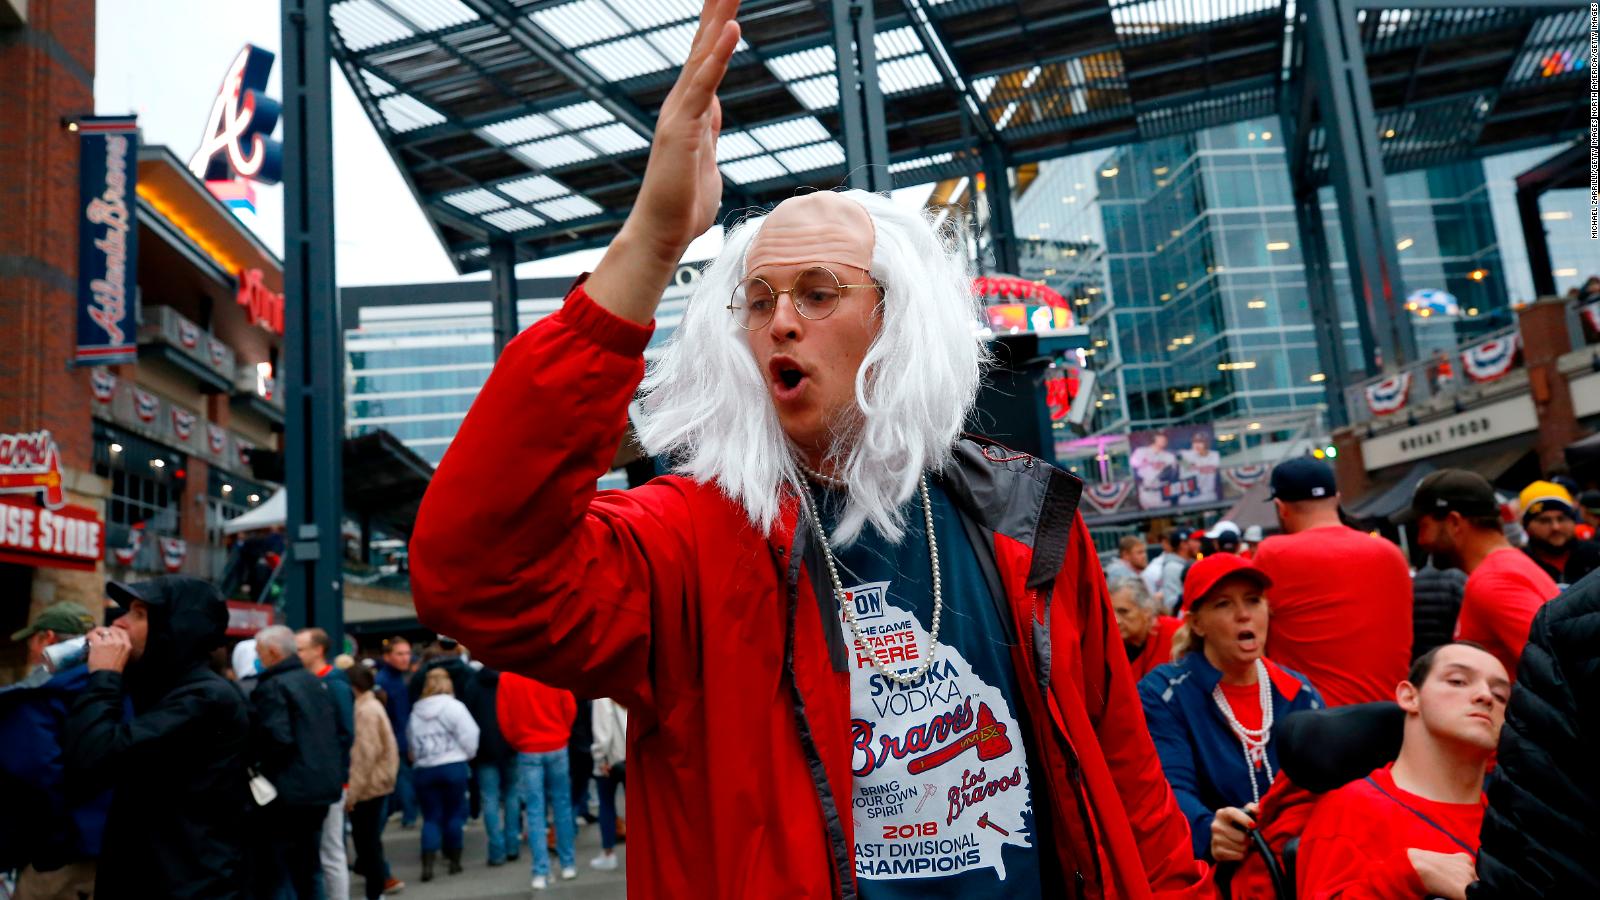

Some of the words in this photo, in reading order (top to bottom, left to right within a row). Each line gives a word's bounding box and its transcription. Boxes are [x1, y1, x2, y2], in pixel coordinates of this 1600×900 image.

[86, 132, 130, 231] Braves
[87, 226, 126, 346] Atlanta
[1400, 431, 1442, 451] GREAT
[1449, 418, 1490, 438] FOOD
[39, 508, 100, 558] STORE
[854, 592, 881, 615] ON
[851, 626, 877, 637] HE
[878, 620, 912, 633] GAME
[854, 630, 915, 650] STARTS
[856, 643, 919, 668] HERE
[872, 679, 962, 718] VODKA
[851, 695, 974, 777] Braves
[860, 780, 900, 796] BRING
[961, 767, 986, 792] Los
[886, 786, 918, 804] OWN
[946, 766, 1022, 826] Bravos
[867, 803, 904, 819] SPIRIT
[882, 821, 938, 839] 2018
[889, 832, 980, 858] DIVISIONAL
